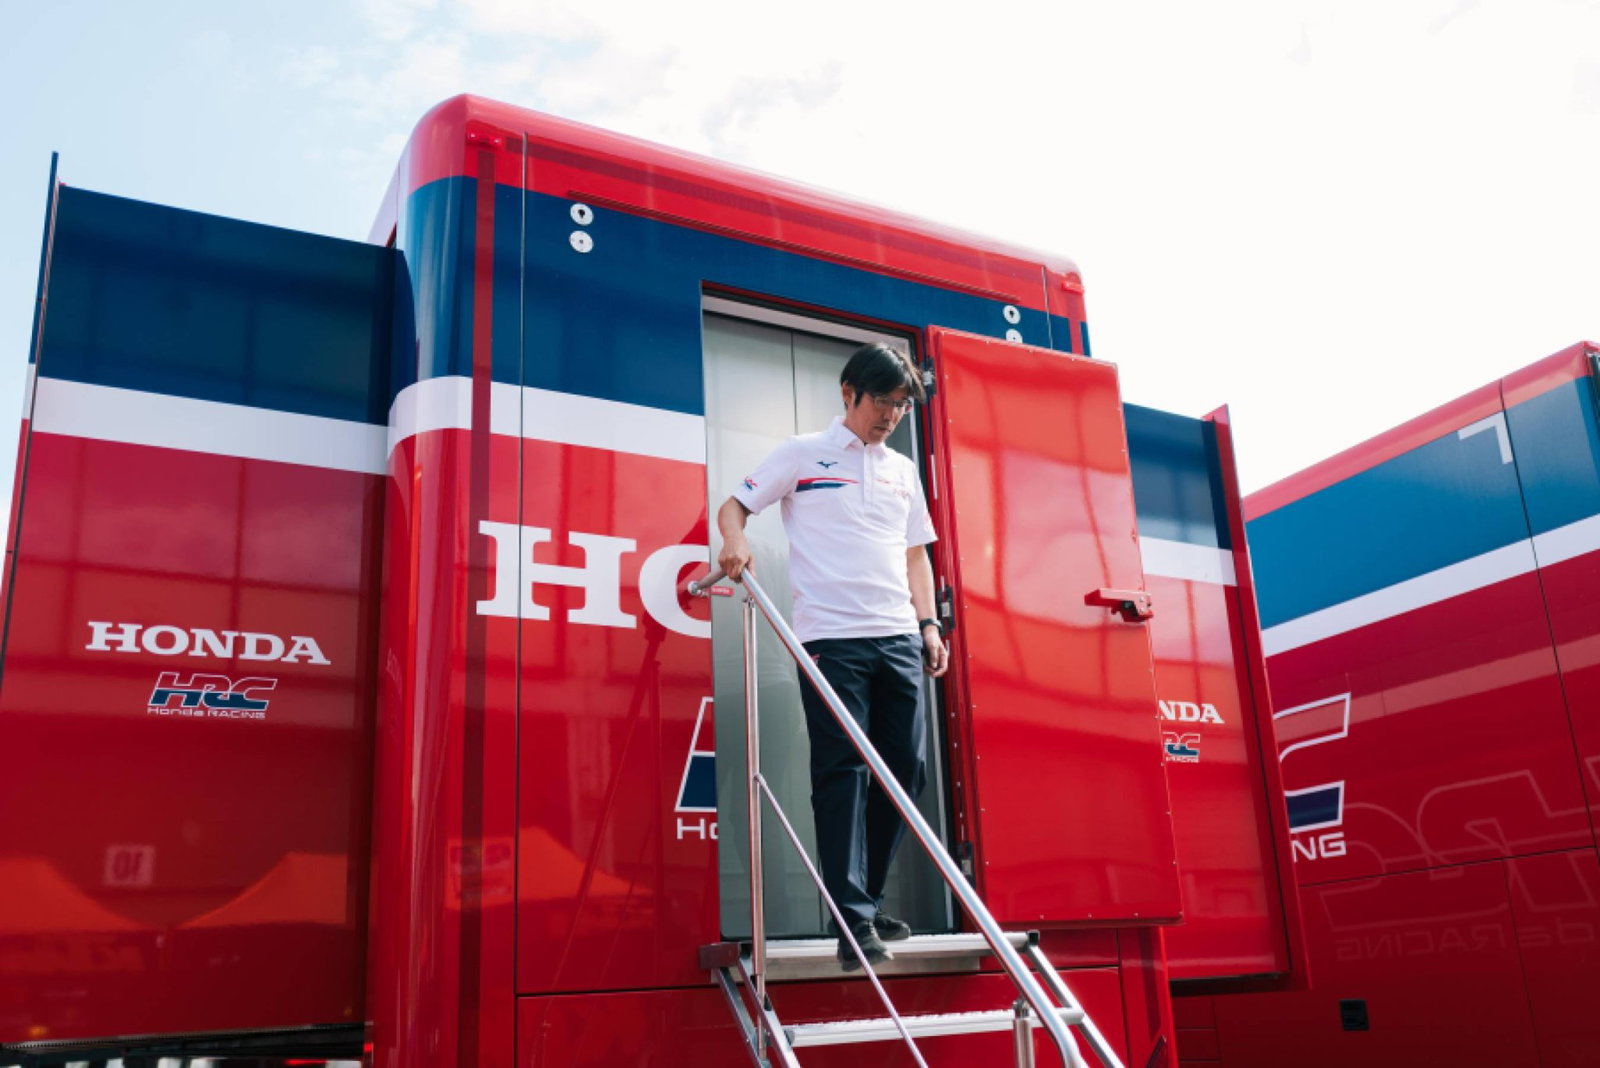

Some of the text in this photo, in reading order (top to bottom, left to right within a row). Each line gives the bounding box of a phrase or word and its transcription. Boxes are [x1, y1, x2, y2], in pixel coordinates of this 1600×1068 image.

[85, 621, 332, 665] HONDA
[148, 671, 278, 711] HRC
[147, 706, 266, 719] Honda RACING
